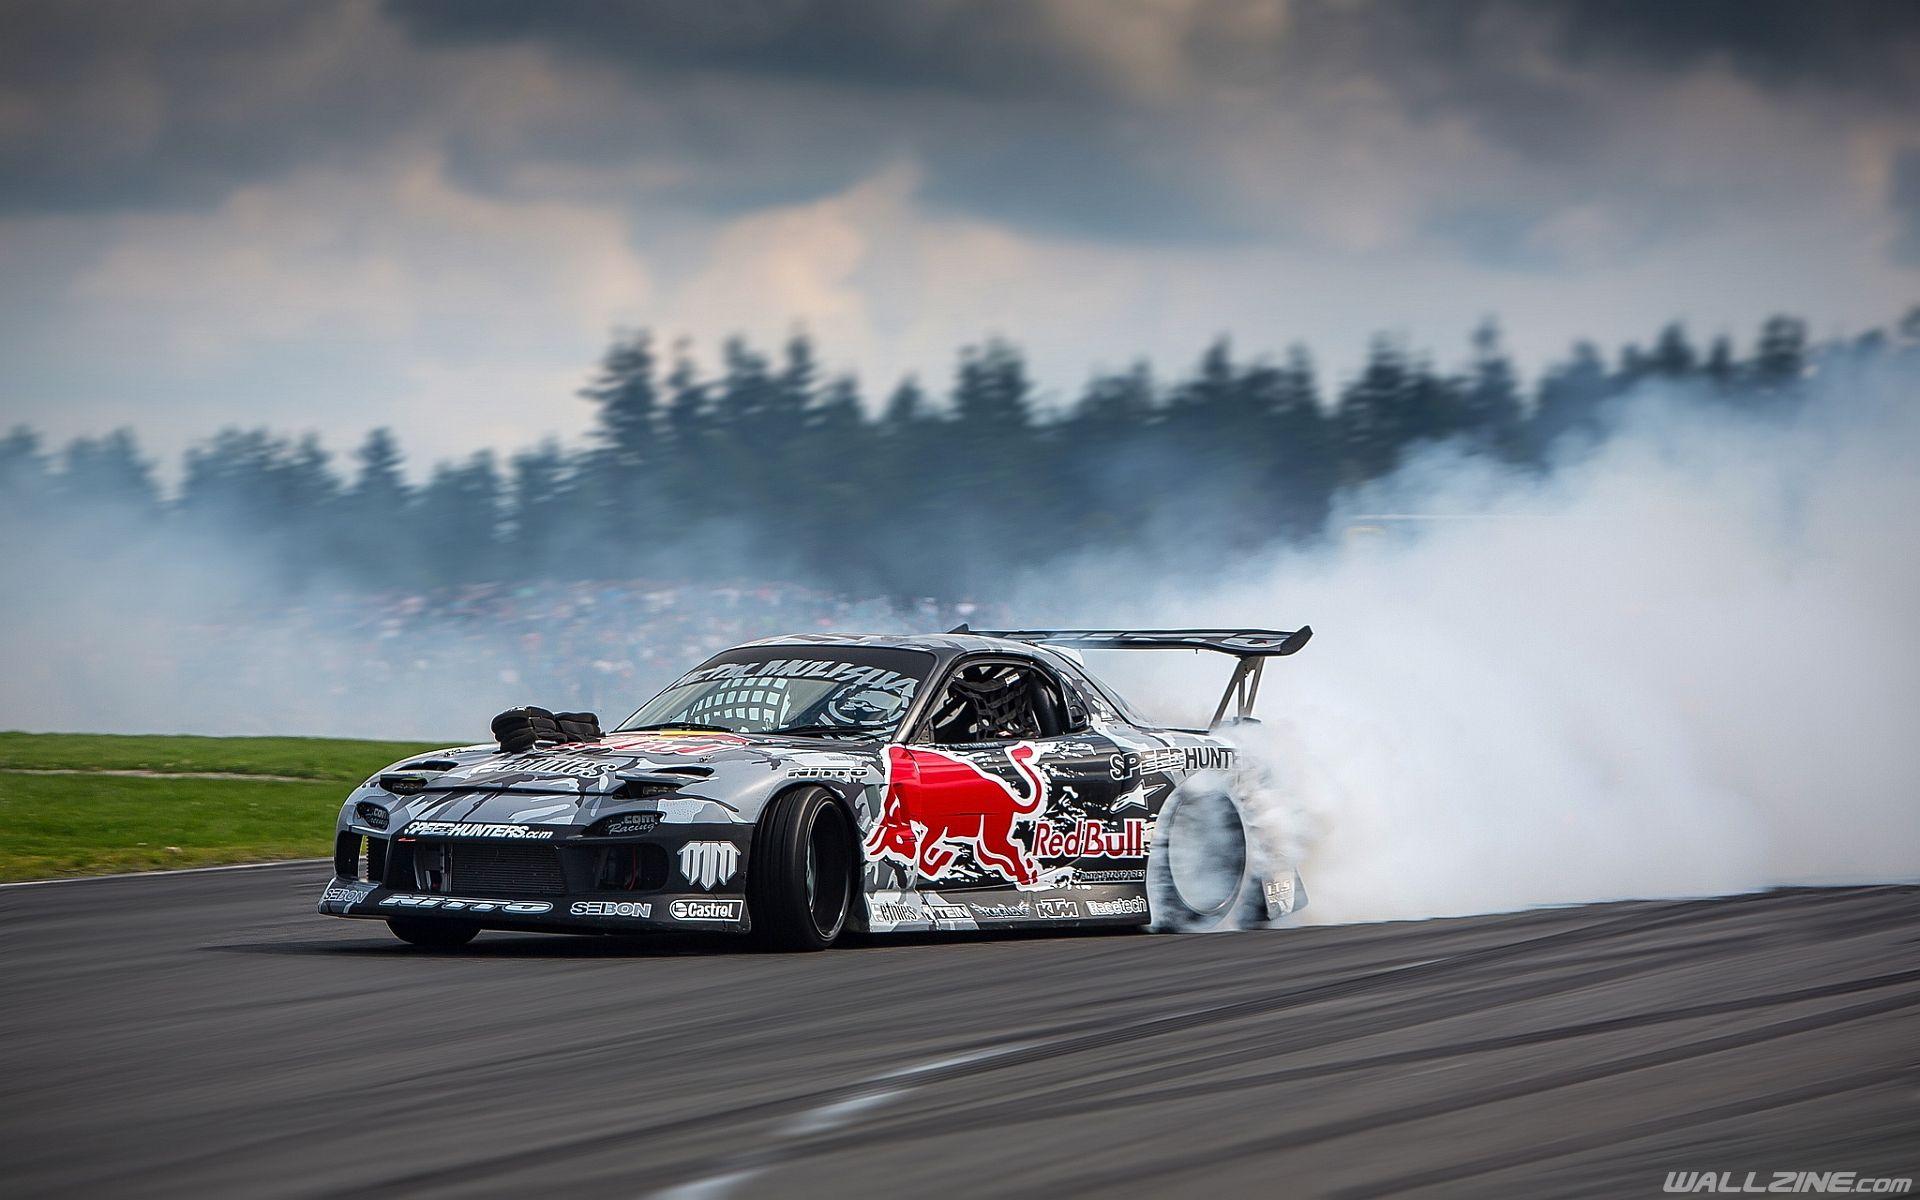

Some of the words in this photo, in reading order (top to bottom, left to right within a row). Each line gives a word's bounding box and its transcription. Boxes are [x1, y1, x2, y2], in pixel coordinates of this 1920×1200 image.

[757, 660, 919, 699] MULISHA
[787, 767, 869, 779] NITTO
[608, 823, 655, 835] Racing
[1031, 818, 1083, 858] Red
[1081, 818, 1145, 858] Bull
[323, 888, 368, 904] SEIBON
[379, 893, 553, 913] NITTO
[570, 901, 652, 918] SEIBON
[687, 903, 733, 918] Castrol
[933, 905, 971, 919] TEIN
[1036, 898, 1079, 918] KTM
[1086, 896, 1147, 916] Racetech
